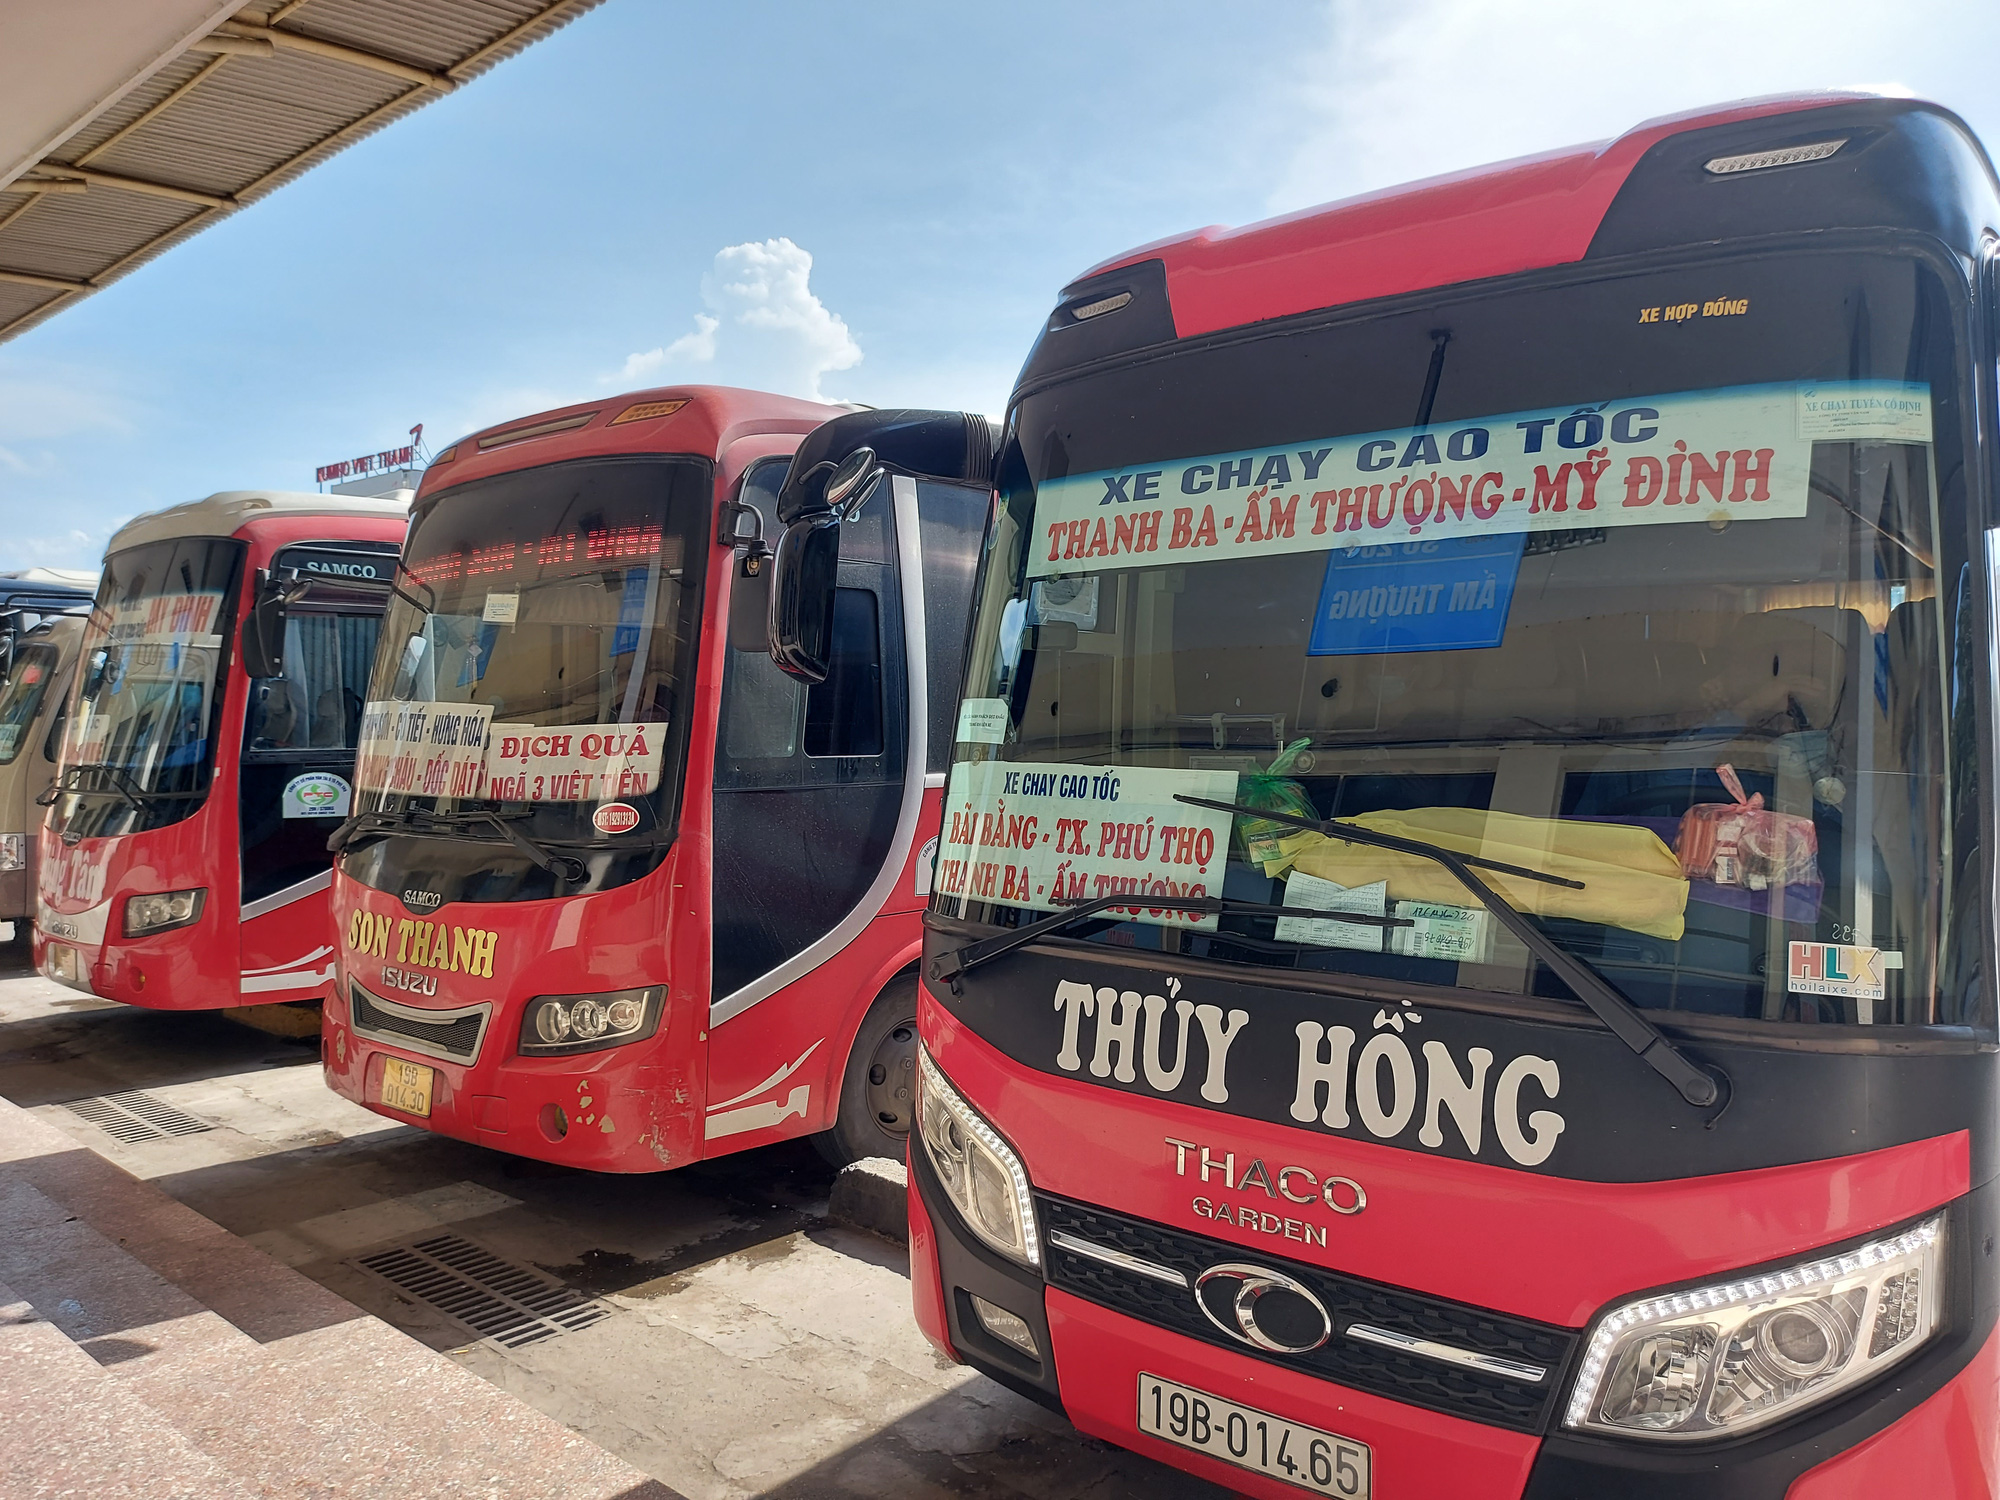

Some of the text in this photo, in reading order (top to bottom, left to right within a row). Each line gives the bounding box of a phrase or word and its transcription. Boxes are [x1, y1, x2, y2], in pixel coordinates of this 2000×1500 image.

[1639, 307, 1660, 324] XE
[1664, 303, 1698, 324] HỢP
[1805, 401, 1819, 412] XE
[1820, 400, 1847, 413] CHẠY
[1099, 400, 1659, 505] XE CHẠY CAO TỐC
[1047, 510, 1163, 561] THANH
[1528, 446, 1611, 514] MỸ
[1622, 439, 1775, 508] ĐÌNH
[307, 560, 377, 579] SAMCO
[406, 705, 427, 743] TIẾT
[460, 709, 486, 747] HÓA
[500, 734, 573, 765] ĐỊCH
[579, 725, 650, 760] QUẢ
[489, 771, 529, 801] NGÃ
[532, 775, 545, 801] 3
[600, 766, 649, 799] TIẾN
[1003, 772, 1020, 795] XE
[1059, 774, 1089, 800] CAO
[1091, 769, 1121, 801] TỐC
[949, 802, 979, 845] BÃI
[1097, 816, 1154, 862] PHÚ
[1160, 826, 1214, 875] THỌ
[403, 889, 441, 907] SAMCO
[939, 859, 1000, 898] THANH
[1001, 865, 1031, 902] BA
[1048, 860, 1089, 907] ẤM
[348, 908, 499, 979] SON THANH
[381, 966, 438, 997] ISUZU
[1791, 944, 1881, 986] HLX
[1790, 981, 1882, 998] hoilaixe.com
[1054, 976, 1250, 1104] THỦY
[399, 1064, 418, 1087] 19B
[386, 1083, 425, 1112] 014.30
[1164, 1136, 1368, 1216] THACO
[1192, 1195, 1328, 1249] GARDEN
[1150, 1384, 1360, 1496] 19B-014.65
